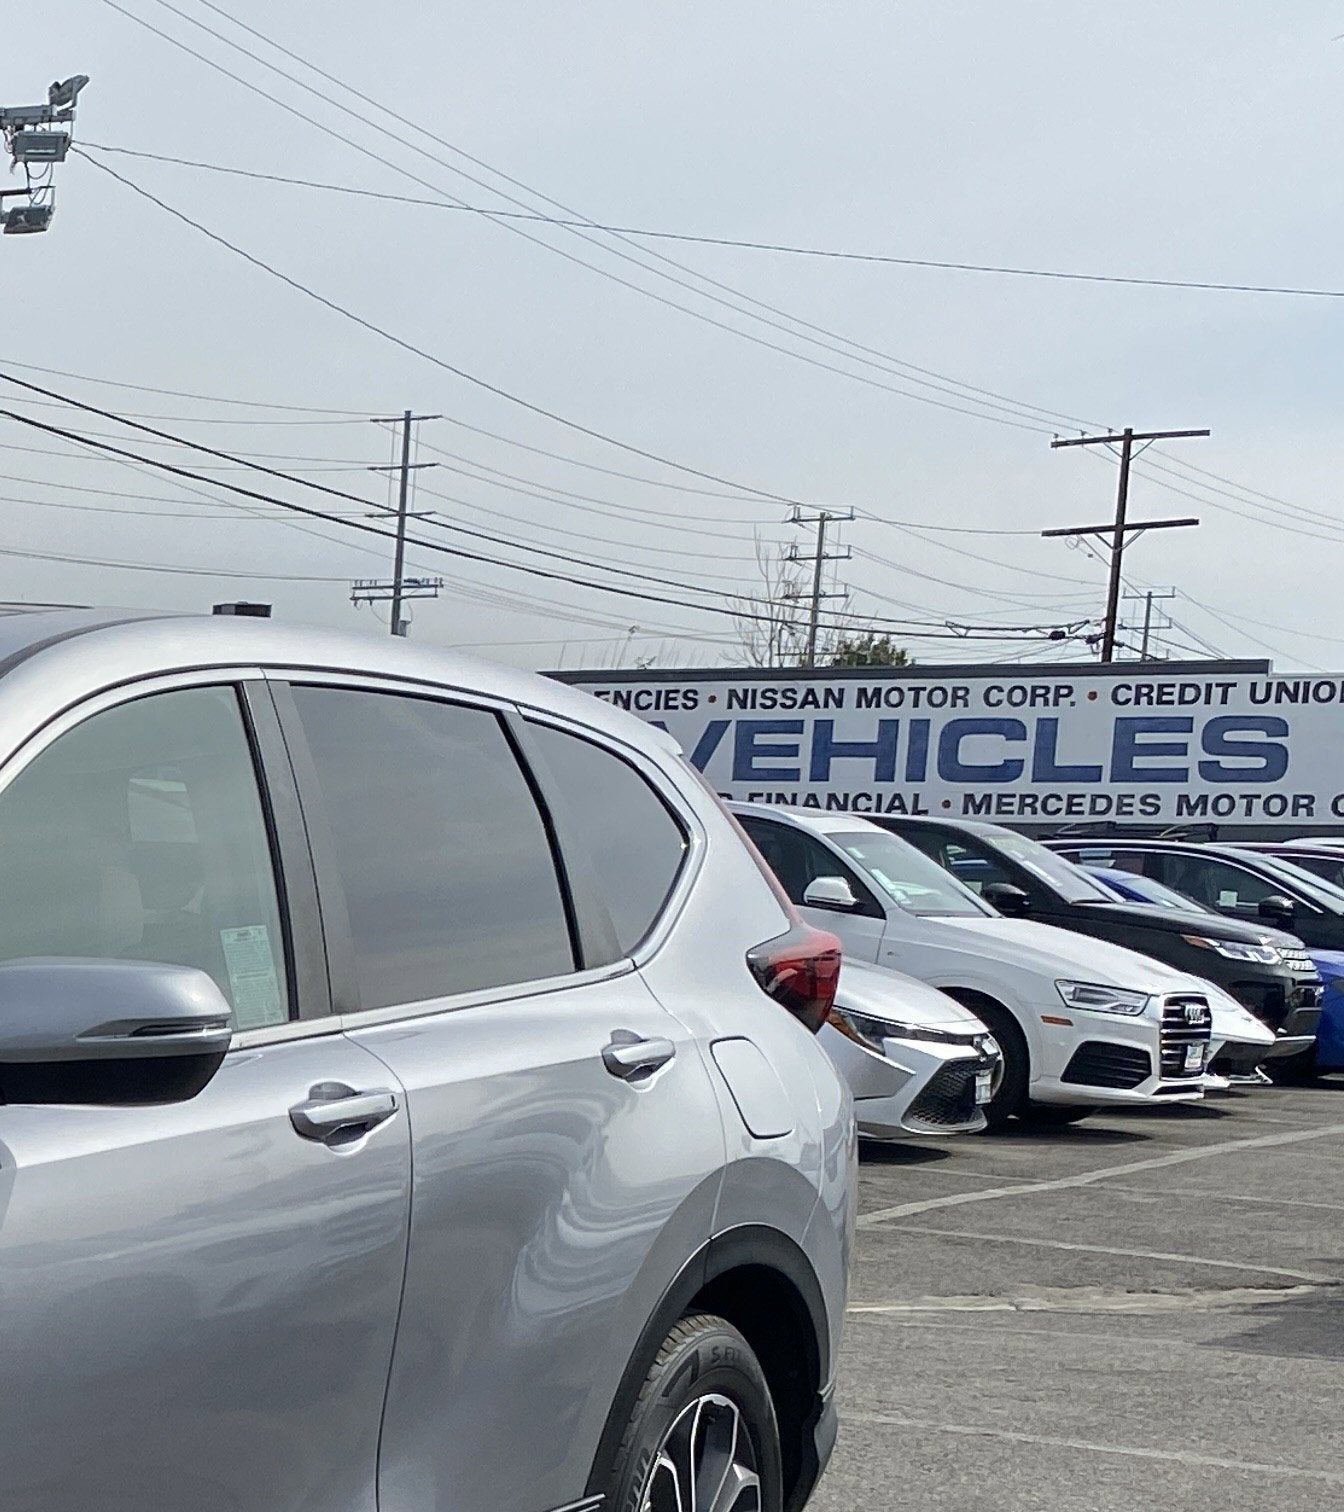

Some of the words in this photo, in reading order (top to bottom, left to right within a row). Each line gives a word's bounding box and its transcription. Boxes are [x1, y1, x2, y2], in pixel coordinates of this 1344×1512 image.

[727, 687, 845, 710] NISSAN
[856, 686, 970, 709] MOTOR
[983, 684, 1076, 708] CORP.
[1111, 681, 1238, 706] CREDIT
[1249, 680, 1344, 705] UNIO
[962, 793, 1162, 816] MERCEDES
[1175, 794, 1316, 817] MOTOR
